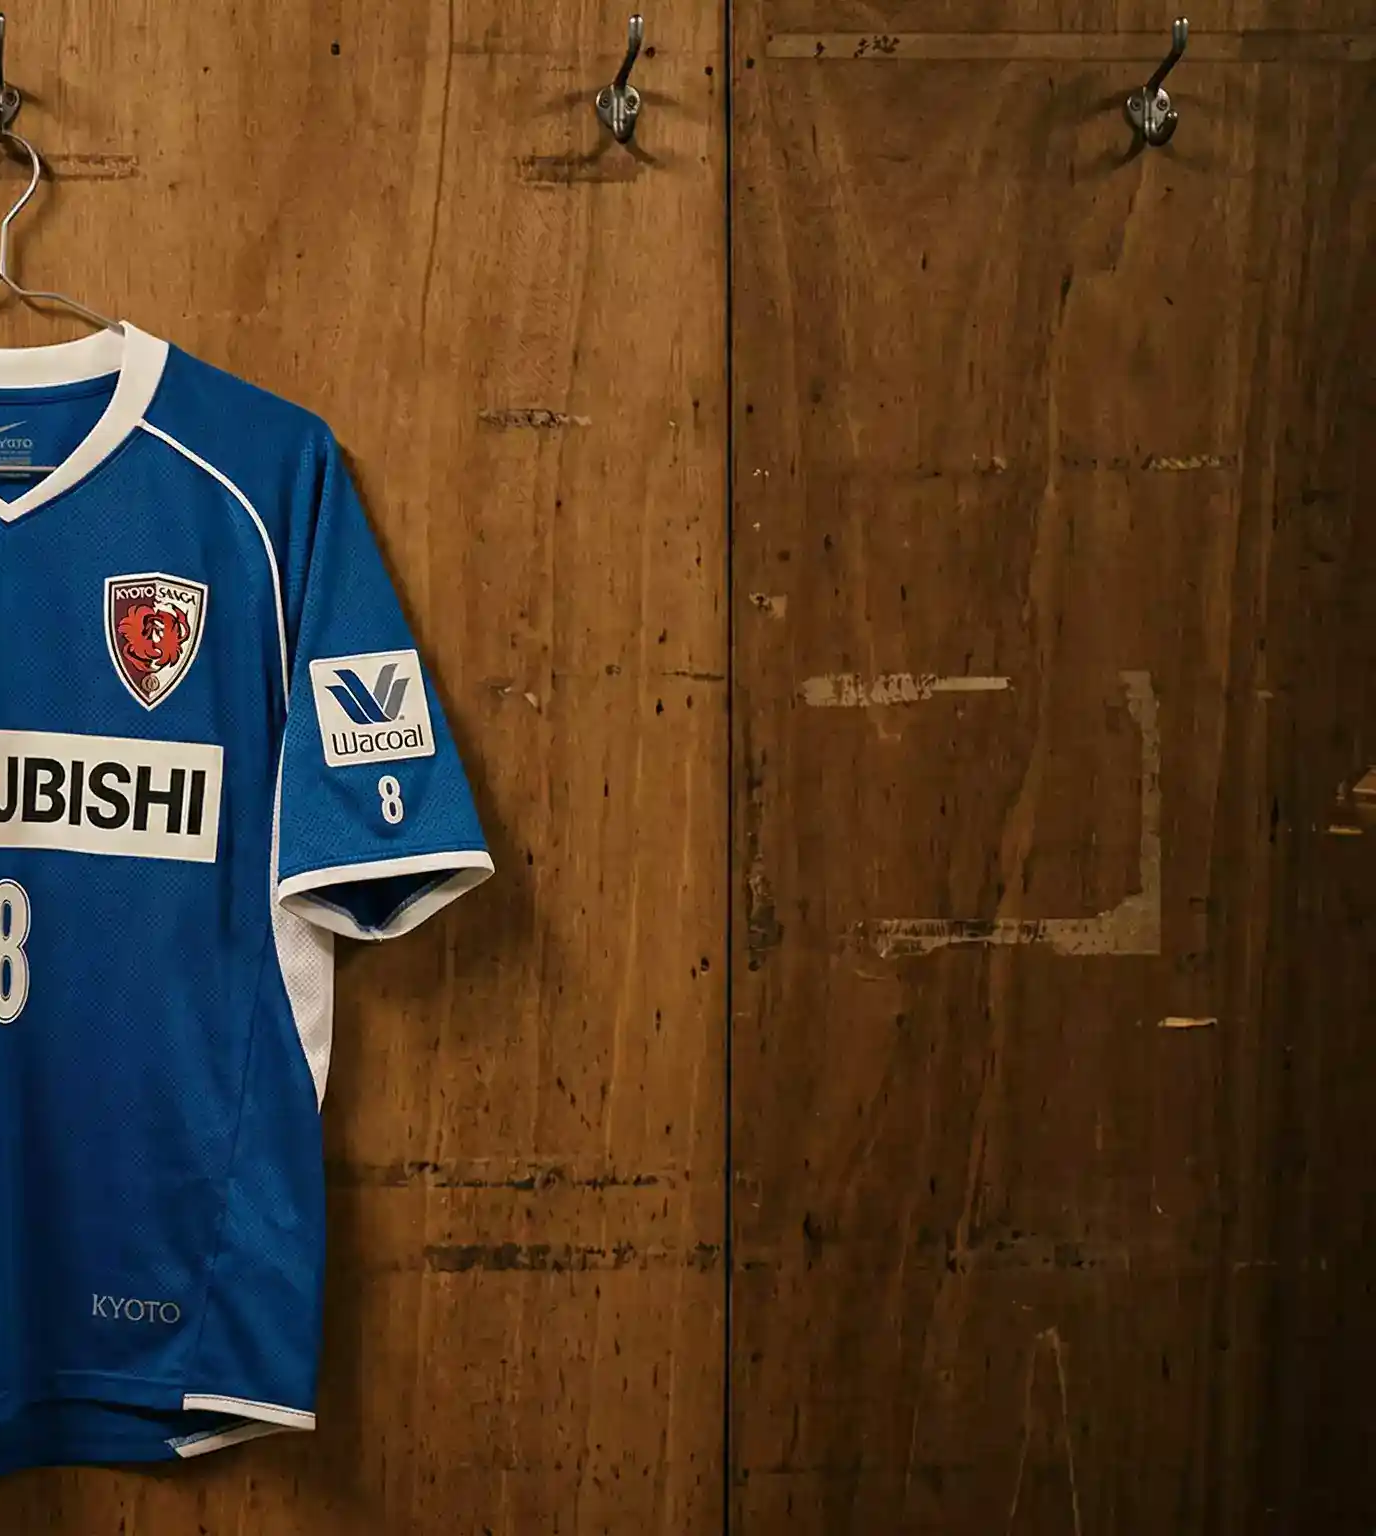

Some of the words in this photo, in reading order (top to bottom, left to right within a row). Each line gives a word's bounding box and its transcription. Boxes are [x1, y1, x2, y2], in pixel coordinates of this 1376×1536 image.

[115, 586, 154, 600] KYOTO
[331, 724, 424, 756] Wacoal
[377, 775, 404, 824] 8
[92, 1293, 181, 1324] KYOTO
